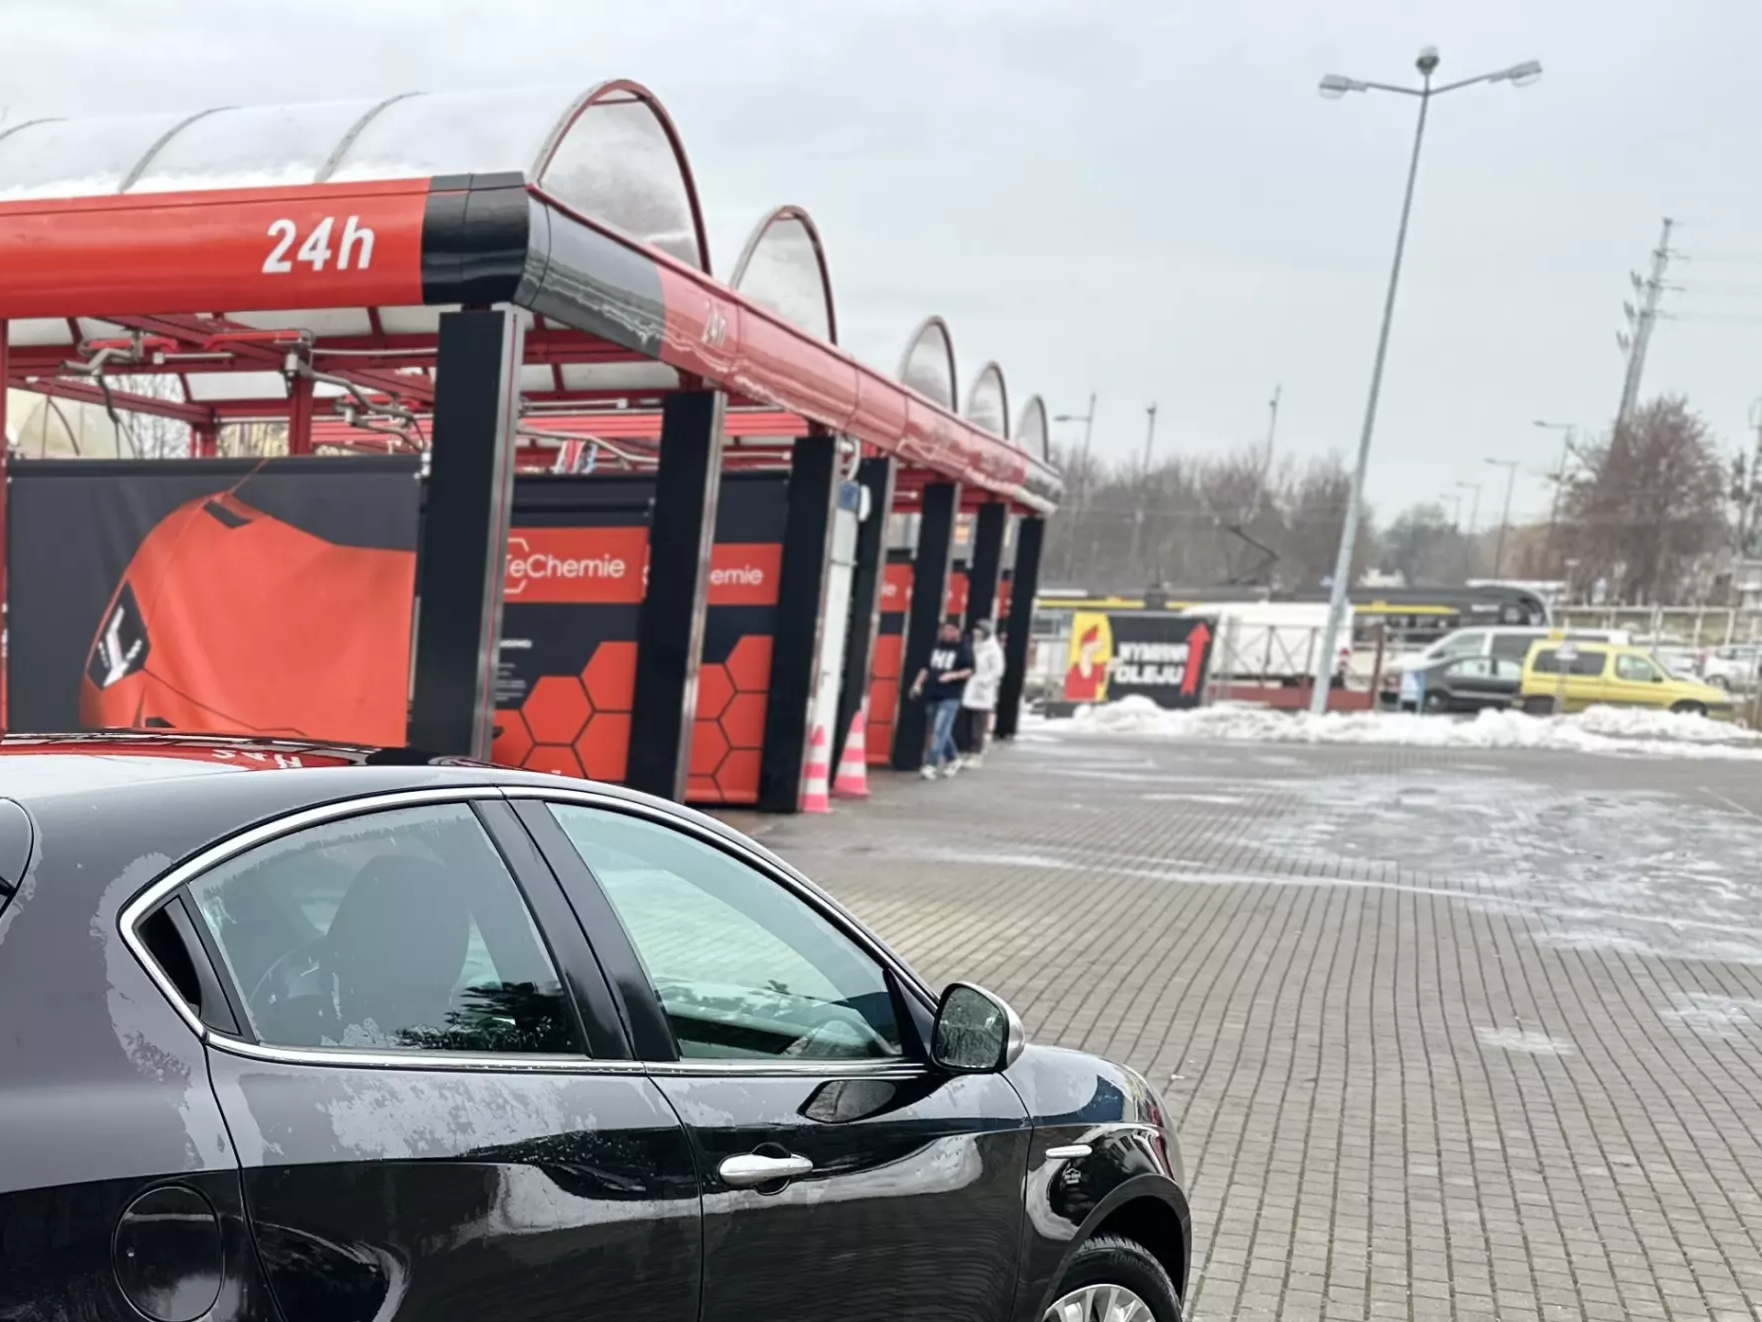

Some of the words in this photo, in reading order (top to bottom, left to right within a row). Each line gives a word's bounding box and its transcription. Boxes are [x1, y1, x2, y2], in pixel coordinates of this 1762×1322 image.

[261, 215, 375, 274] 24h
[709, 564, 764, 585] emie
[1115, 664, 1184, 684] OLEJU
